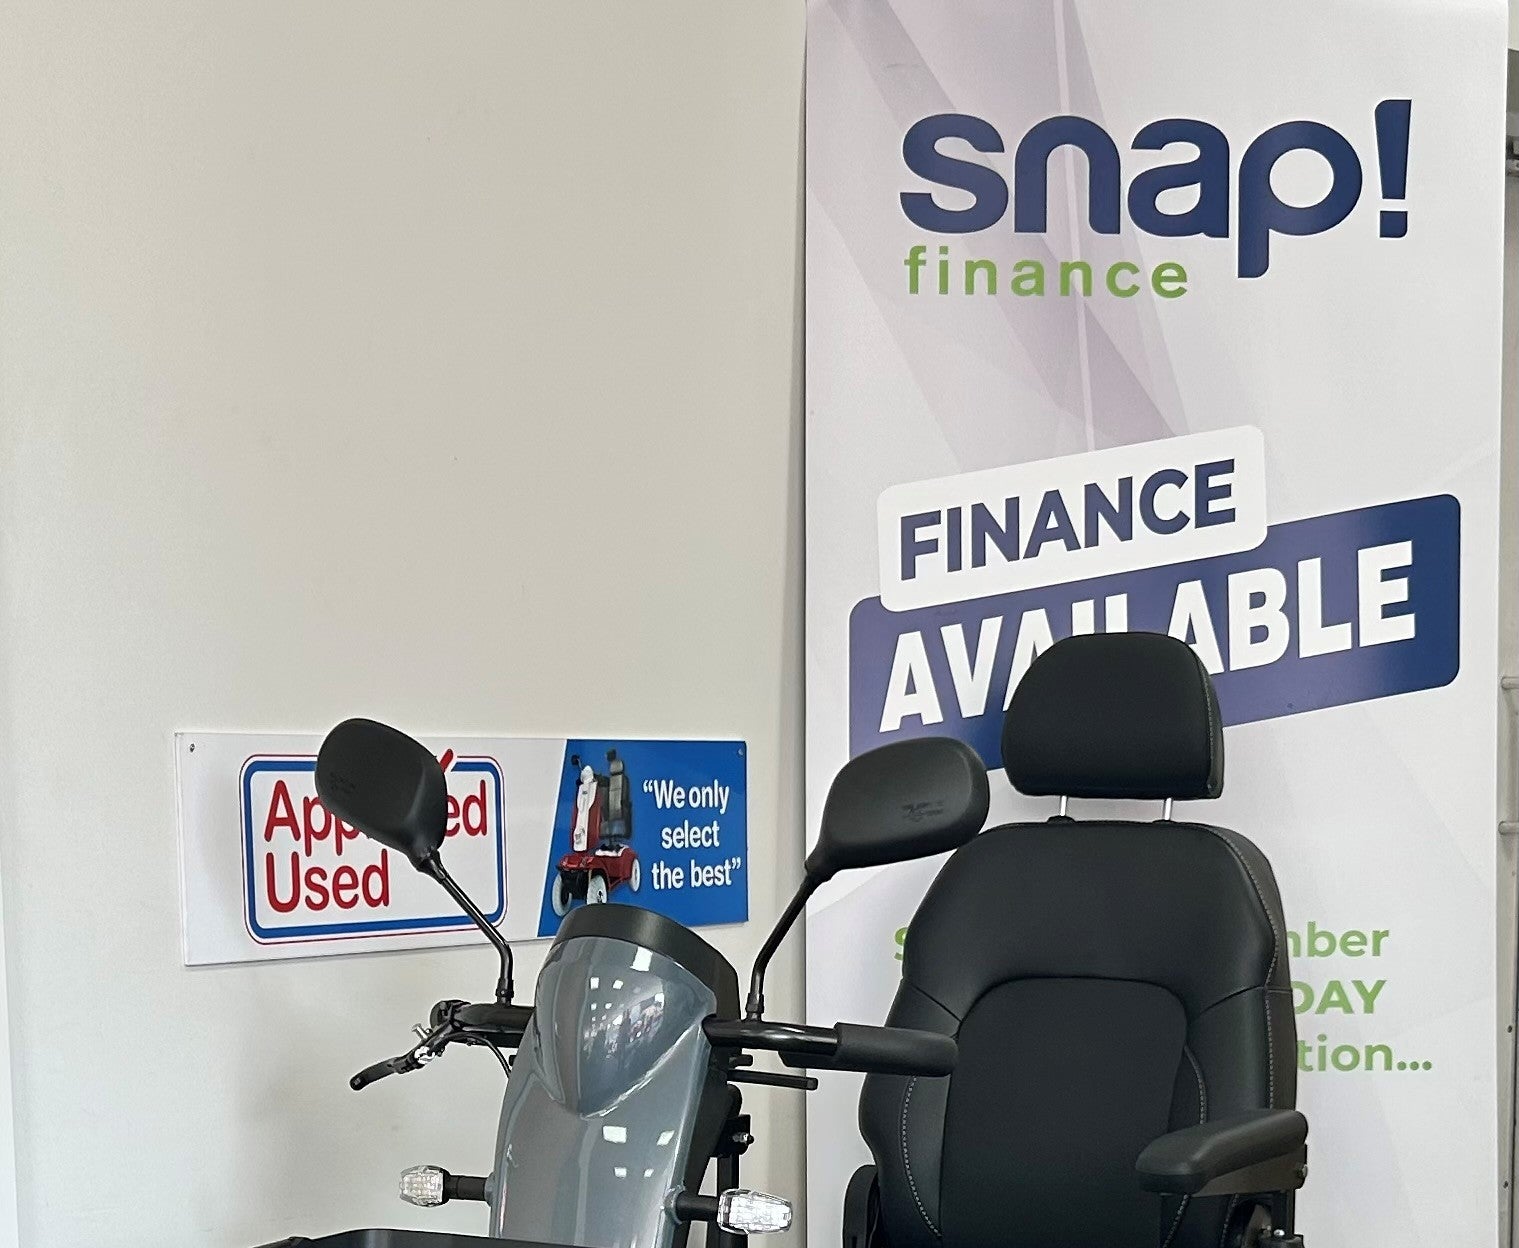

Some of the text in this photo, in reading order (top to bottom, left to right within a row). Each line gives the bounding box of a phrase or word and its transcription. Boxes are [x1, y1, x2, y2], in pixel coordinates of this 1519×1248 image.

[899, 99, 1412, 278] snap!
[904, 246, 1188, 299] finance
[900, 458, 1236, 581] FINANCE
[688, 779, 730, 815] only
[661, 819, 720, 850] select
[265, 848, 390, 913] Used
[652, 860, 684, 890] the
